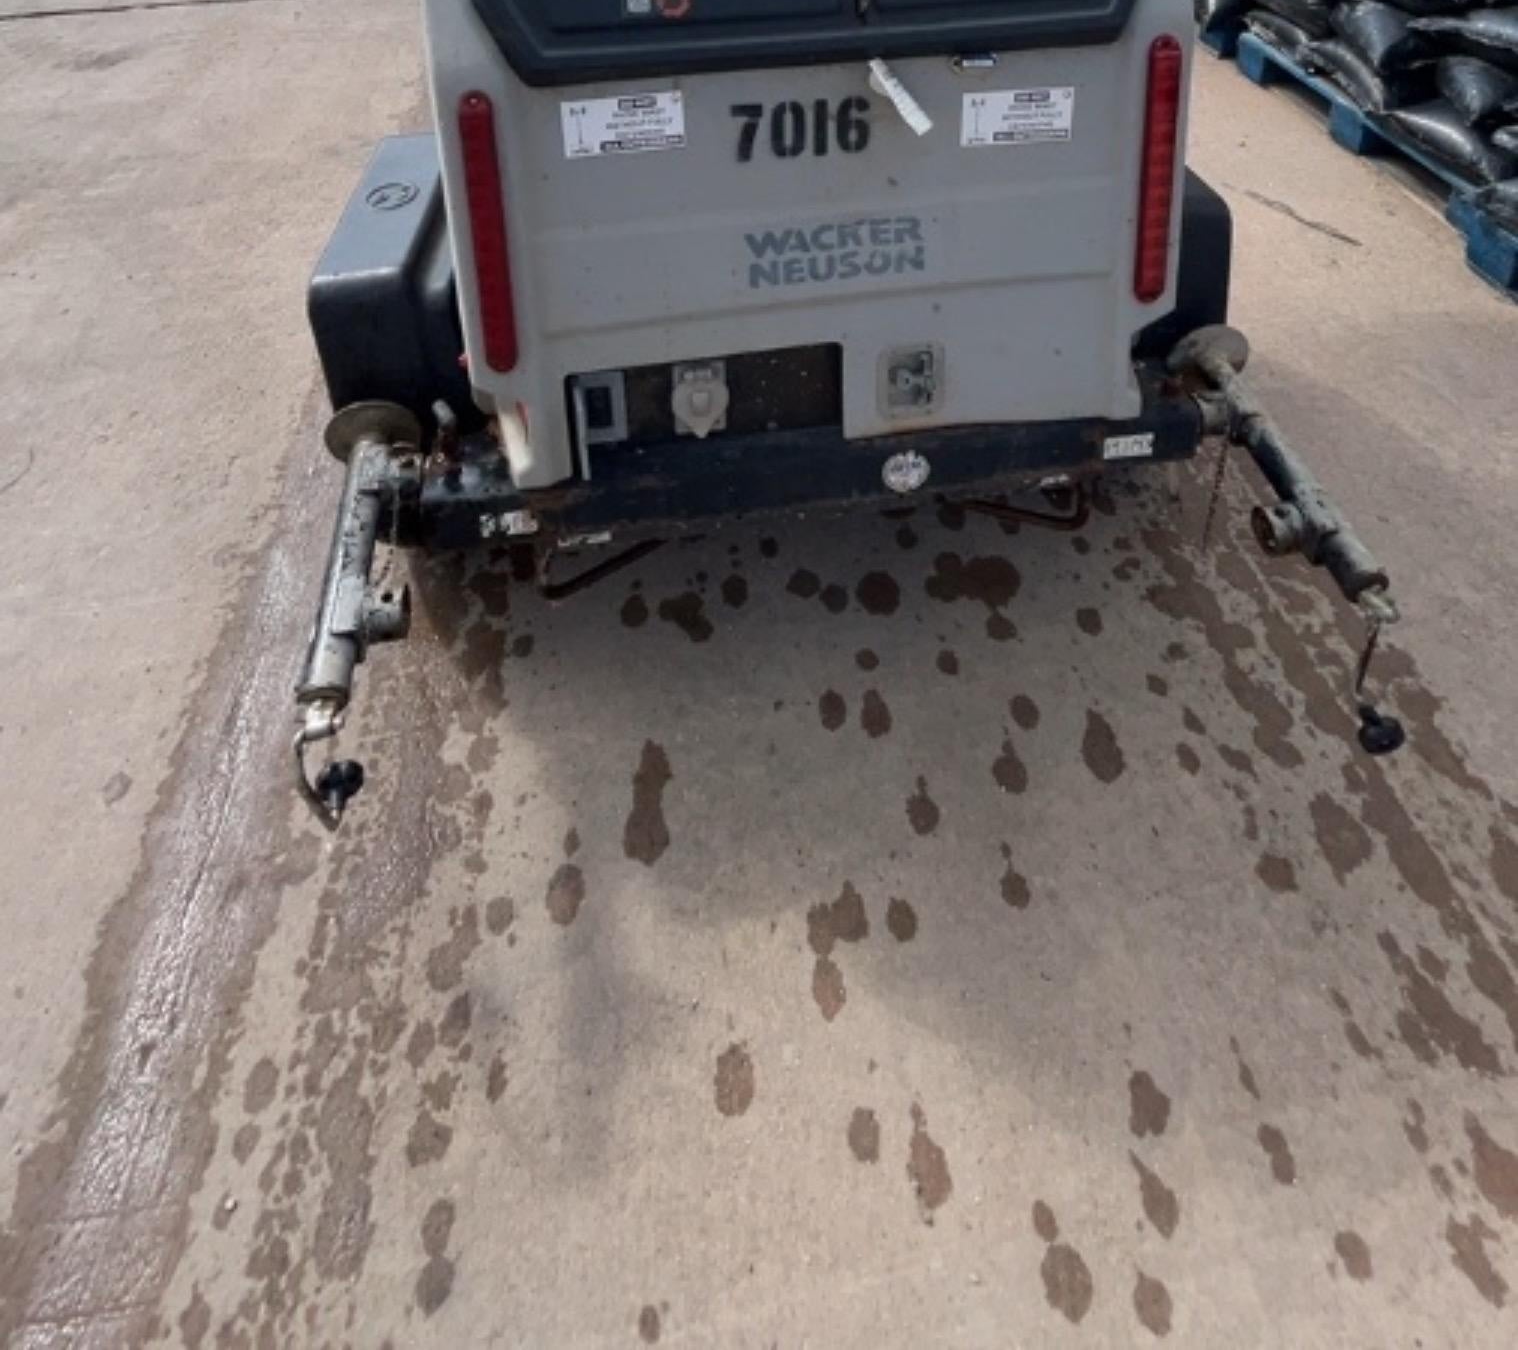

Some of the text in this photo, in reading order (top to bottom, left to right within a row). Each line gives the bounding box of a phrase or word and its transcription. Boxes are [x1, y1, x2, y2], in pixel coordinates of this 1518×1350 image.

[731, 95, 871, 163] 7016
[744, 215, 925, 259] WACKER
[749, 245, 925, 289] NEUSON
